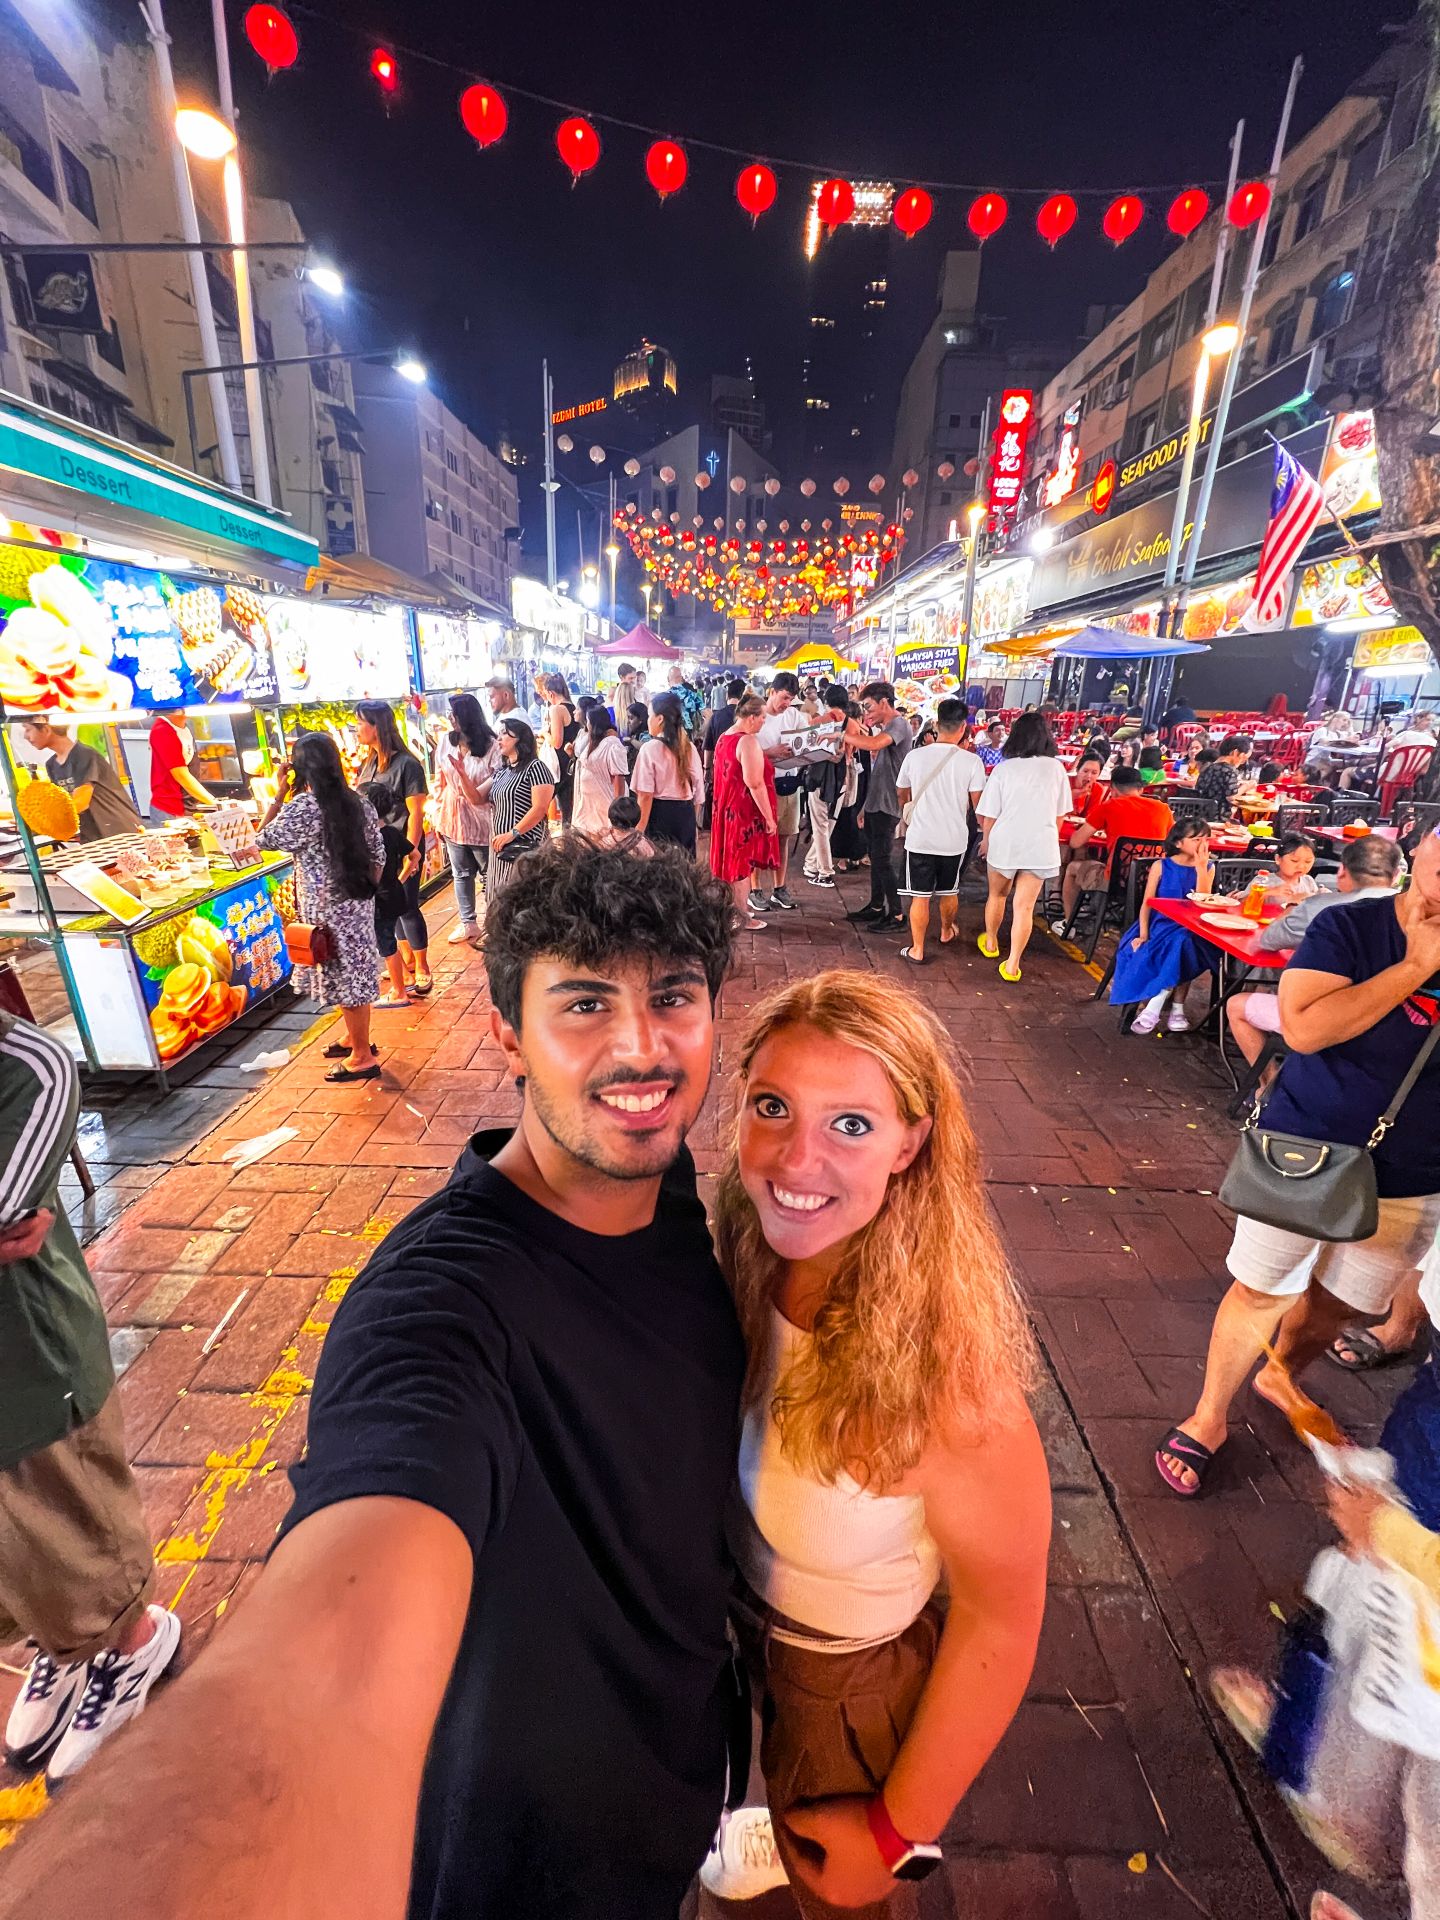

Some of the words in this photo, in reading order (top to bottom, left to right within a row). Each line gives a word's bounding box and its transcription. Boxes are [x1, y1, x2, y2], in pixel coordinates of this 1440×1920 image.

[578, 397, 607, 416] HOTEL
[59, 455, 132, 500] Dessert
[1120, 439, 1177, 488] SEAFOOD
[219, 514, 264, 545] Dessert
[1091, 533, 1131, 580] Boleh
[1131, 531, 1172, 567] Seafoo
[897, 651, 934, 664] MALAYSIA
[935, 648, 958, 659] STYLE
[900, 660, 932, 673] VARIOUS
[934, 658, 955, 669] FRIED
